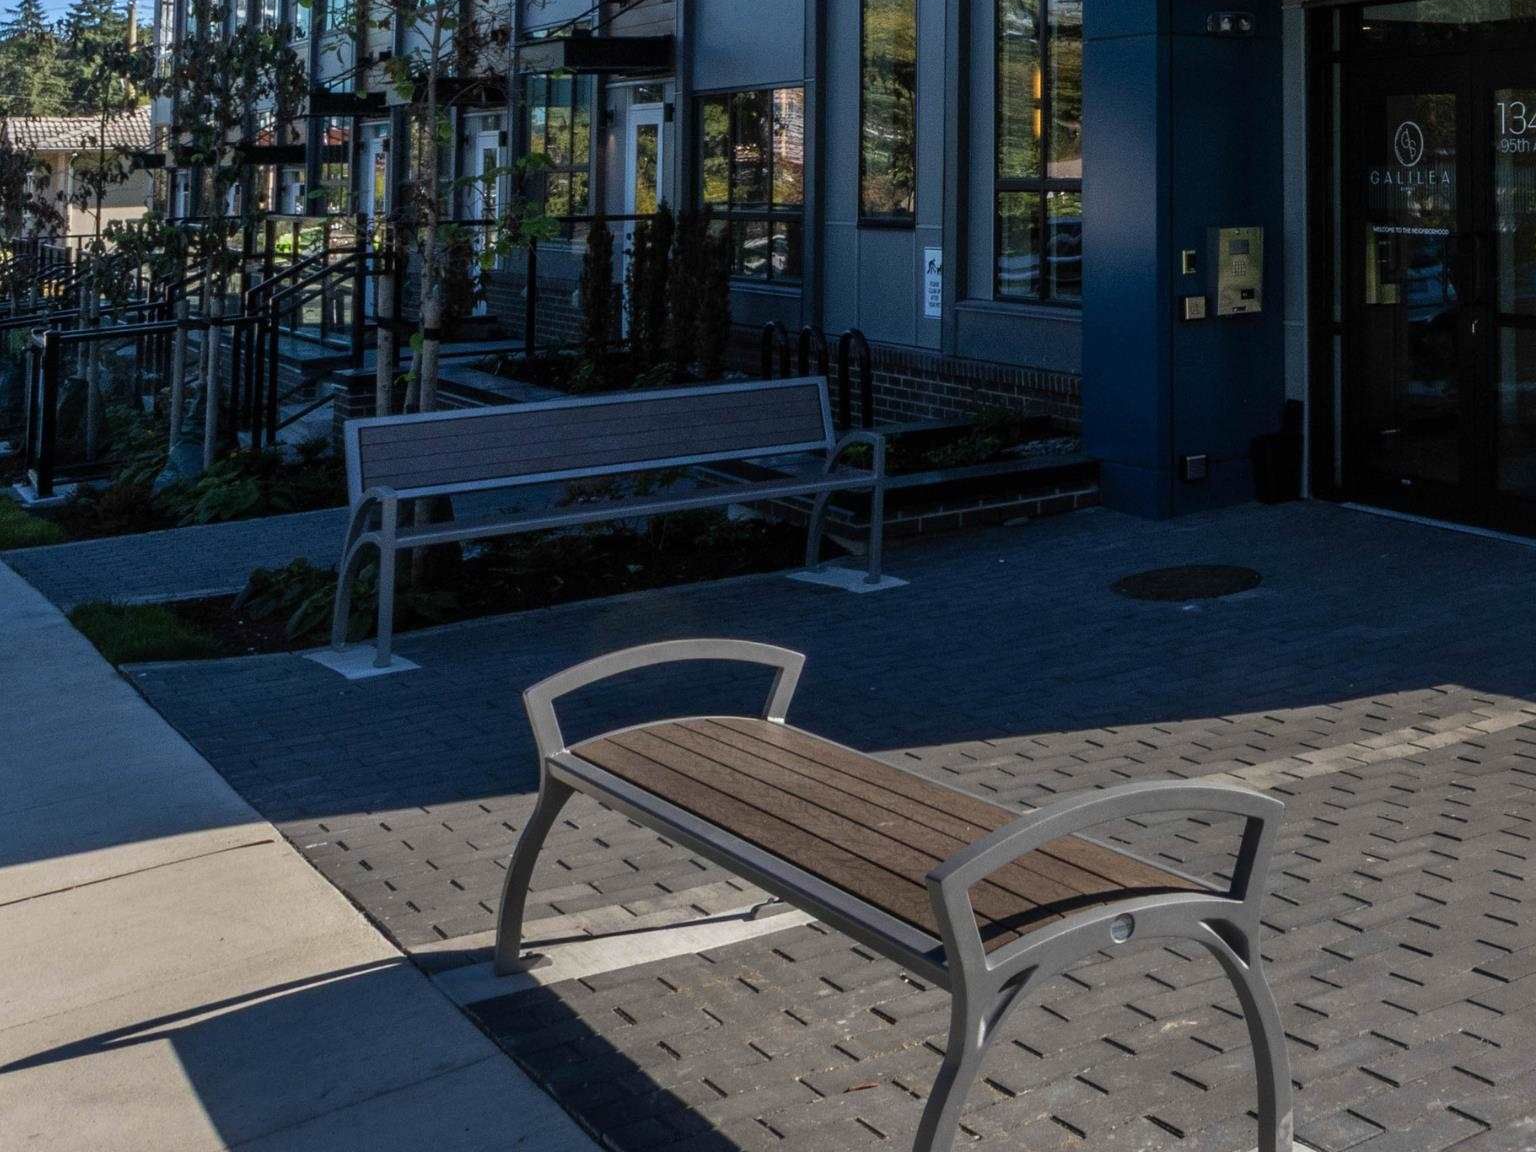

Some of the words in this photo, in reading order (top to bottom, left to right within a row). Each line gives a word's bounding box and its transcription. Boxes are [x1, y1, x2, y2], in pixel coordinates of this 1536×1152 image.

[1500, 137, 1530, 153] 95th
[1370, 170, 1451, 185] GALILEA
[1373, 225, 1394, 233] WELCOME
